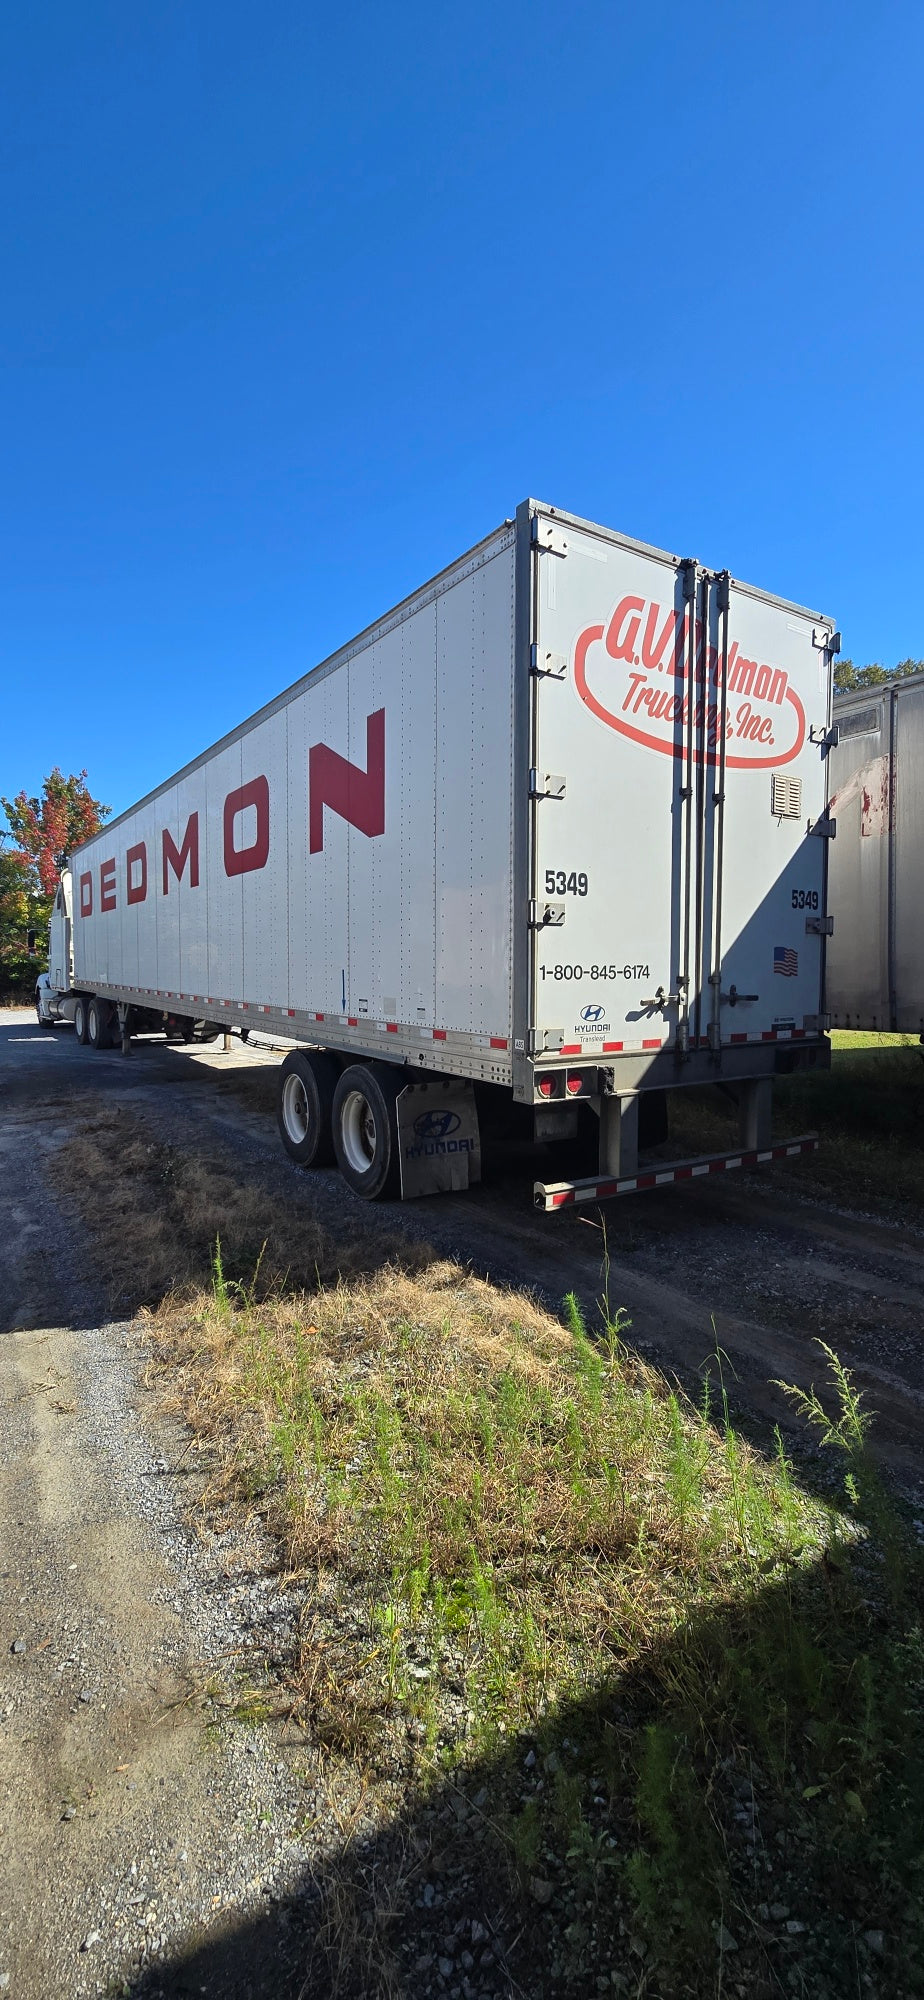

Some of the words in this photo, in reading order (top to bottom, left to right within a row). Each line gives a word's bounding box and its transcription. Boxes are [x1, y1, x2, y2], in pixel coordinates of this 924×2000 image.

[735, 702, 775, 746] Inc.
[80, 706, 386, 919] DEDMON
[544, 869, 589, 897] 5349
[791, 889, 819, 910] 5349
[539, 964, 651, 981] 1-800-845-6174
[574, 1023, 611, 1033] HYUNDAI
[579, 1035, 606, 1043] Translead
[405, 1138, 475, 1159] HYUNDAI
